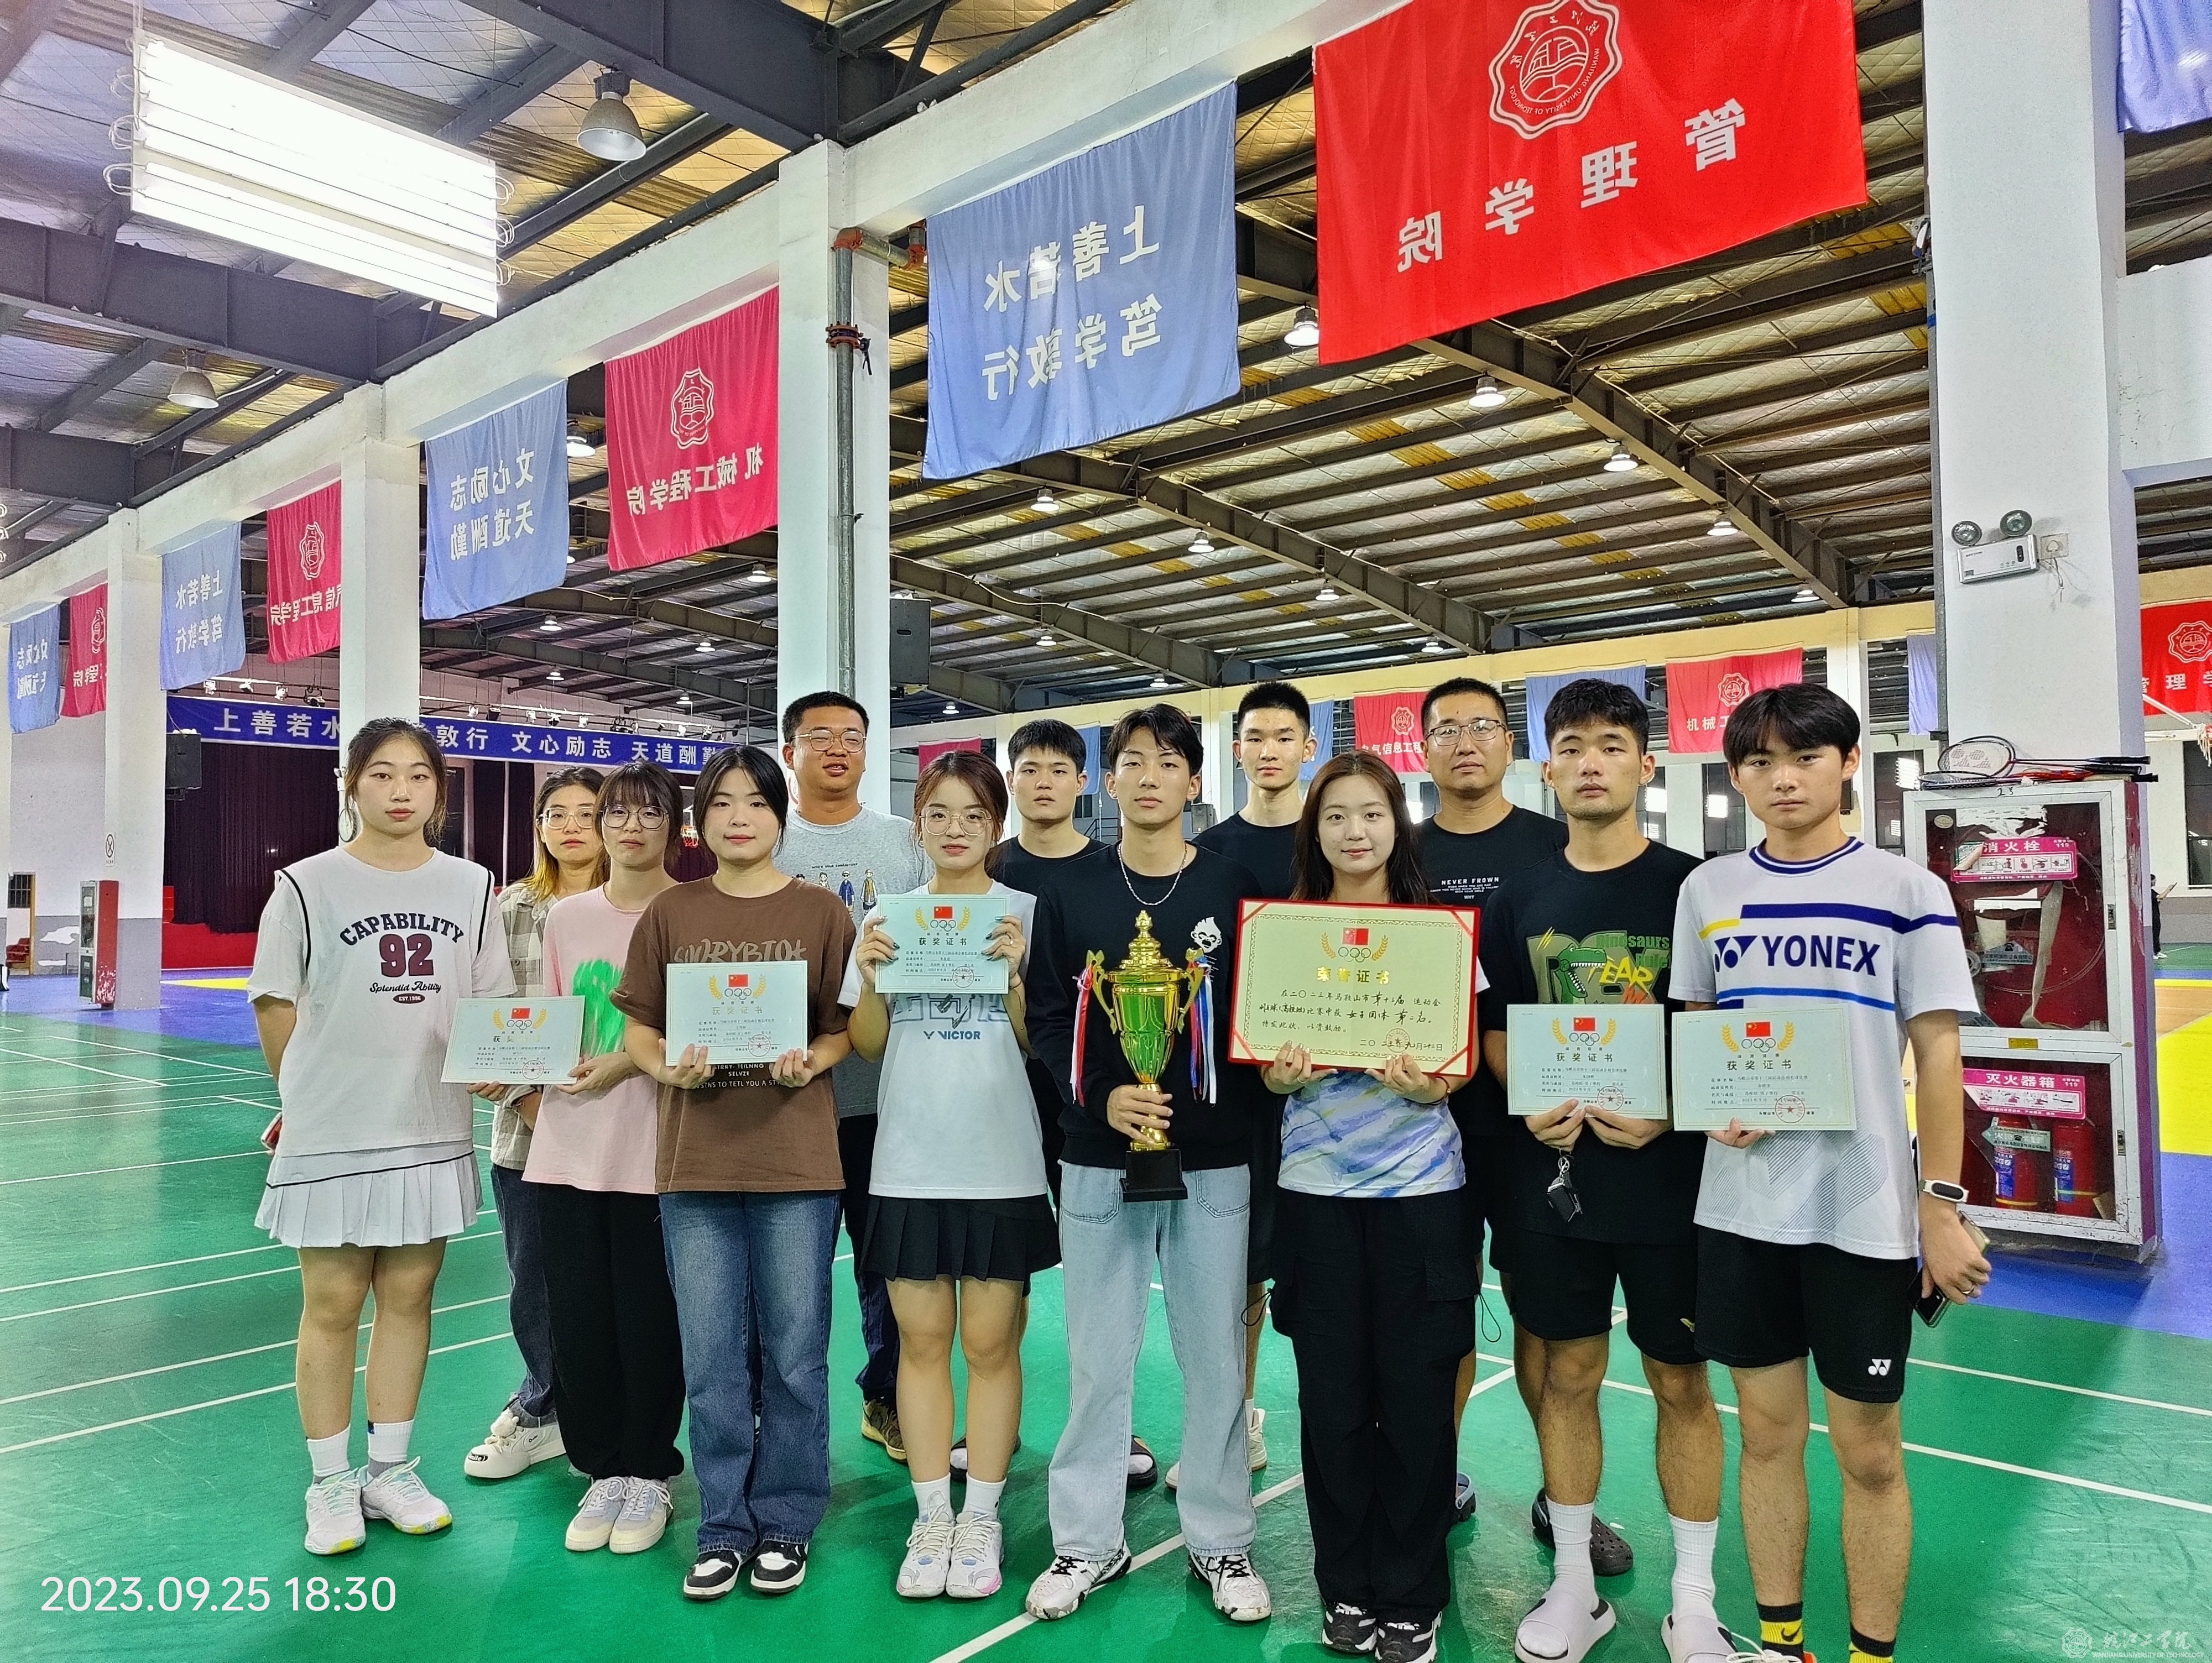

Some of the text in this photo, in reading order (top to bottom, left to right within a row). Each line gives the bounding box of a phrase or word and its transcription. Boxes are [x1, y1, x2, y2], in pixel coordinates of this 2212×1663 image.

[214, 708, 716, 765] 上善若水 敦行 文心励志 天道酬勤
[1983, 840, 2040, 853] 消火栓
[340, 913, 464, 946] CAPABILITY
[919, 937, 967, 946] 获奖证书
[379, 933, 434, 977] 92
[1761, 935, 1881, 976] YONEX
[1317, 966, 1390, 984] 荣誉证书
[370, 981, 441, 993] Splendid Ability
[937, 1031, 980, 1040] VICTOR
[1556, 1053, 1613, 1062] 获奖证书
[1726, 1059, 1792, 1070] 获奖证书
[1985, 1073, 2056, 1089] 灭火器箱
